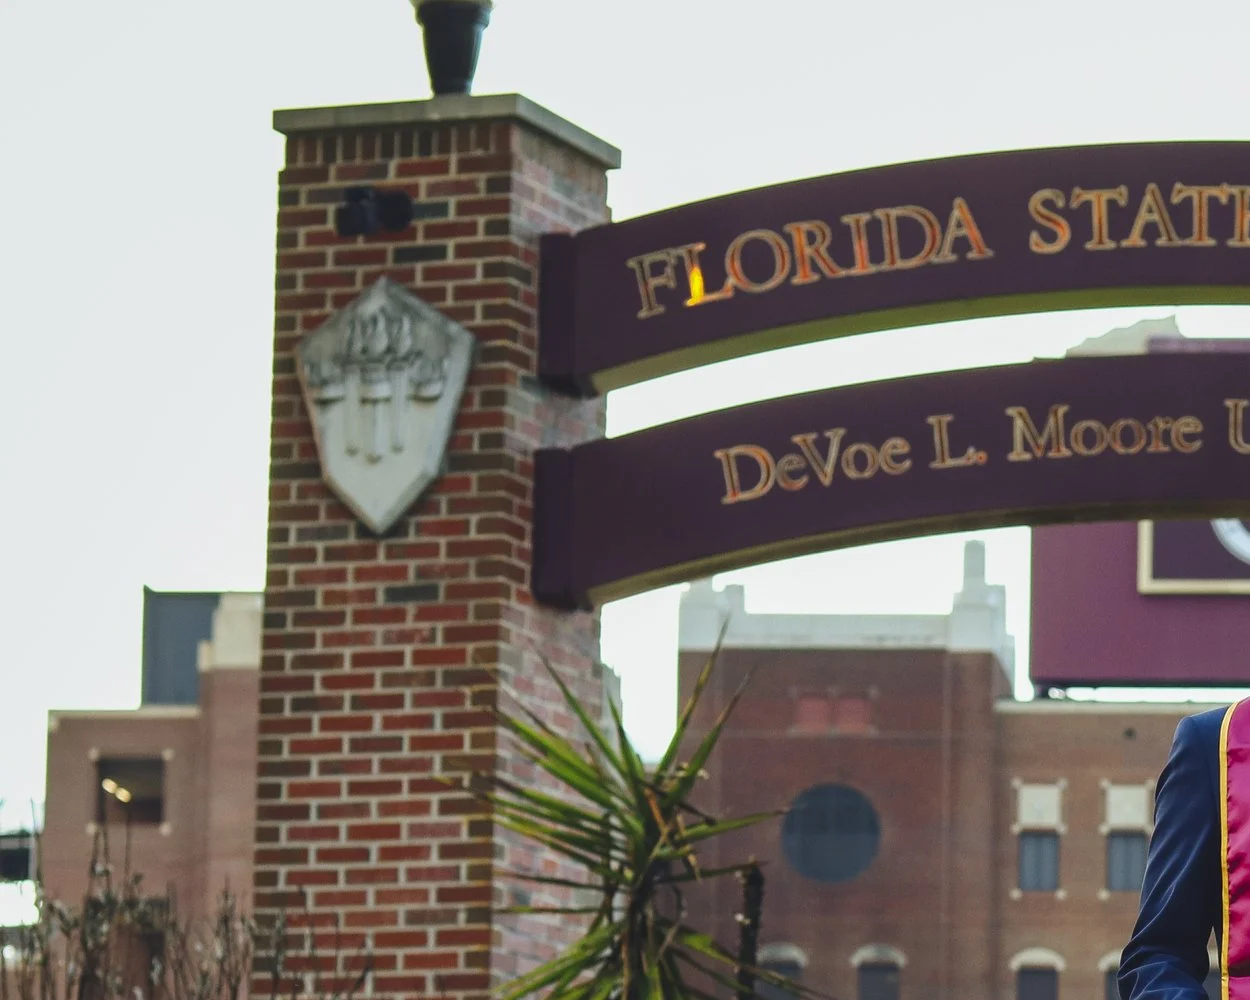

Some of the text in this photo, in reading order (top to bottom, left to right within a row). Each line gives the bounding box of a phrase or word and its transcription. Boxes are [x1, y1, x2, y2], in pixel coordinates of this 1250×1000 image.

[626, 197, 994, 319] FLORIDA
[714, 427, 911, 503] DeVoe
[926, 413, 988, 470] L.
[1005, 404, 1203, 462] Moore
